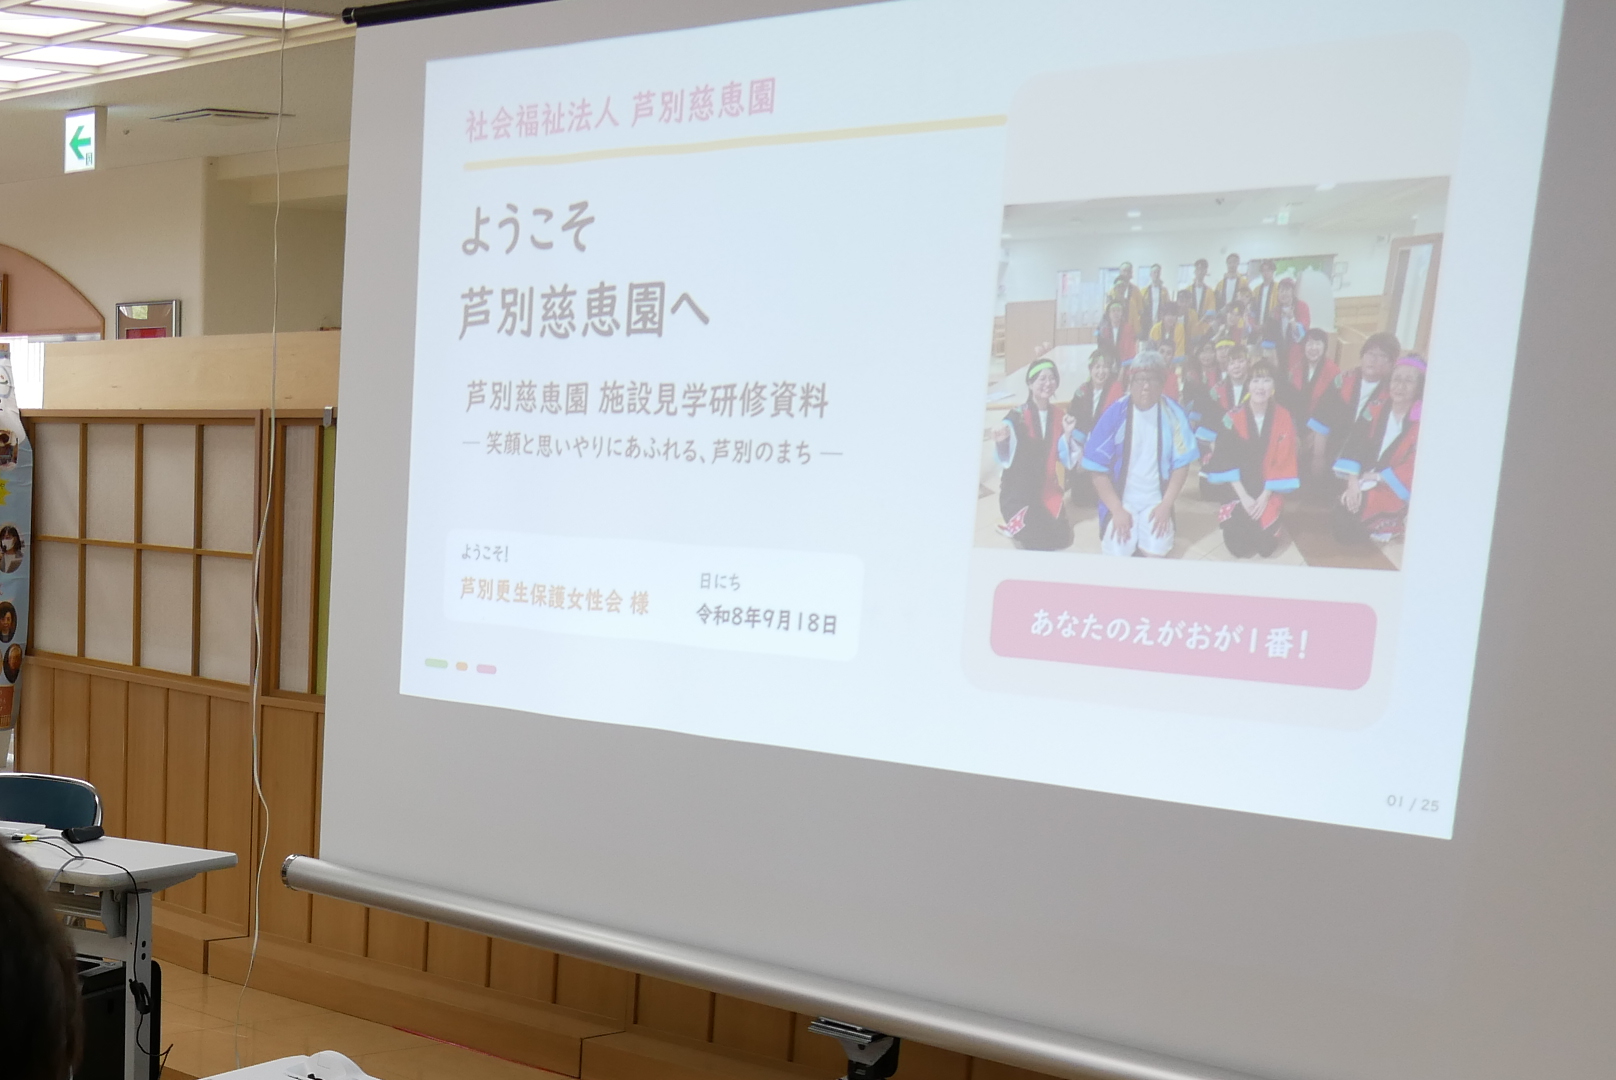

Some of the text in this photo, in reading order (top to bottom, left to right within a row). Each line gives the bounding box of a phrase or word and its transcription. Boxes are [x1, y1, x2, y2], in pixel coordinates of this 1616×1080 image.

[465, 77, 777, 143] 社会福祉法人 芦別慈恵園
[461, 200, 596, 256] ようこそ
[459, 280, 710, 341] 芦別慈恵園へ
[465, 379, 829, 419] 芦別慈恵園 施設見学研修資料
[460, 576, 650, 616] 芦別更生保護女性会 様
[699, 572, 742, 591] 日にち
[696, 602, 838, 635] 令和8年9月18日
[1385, 793, 1405, 808] 01
[1421, 798, 1440, 813] 25
